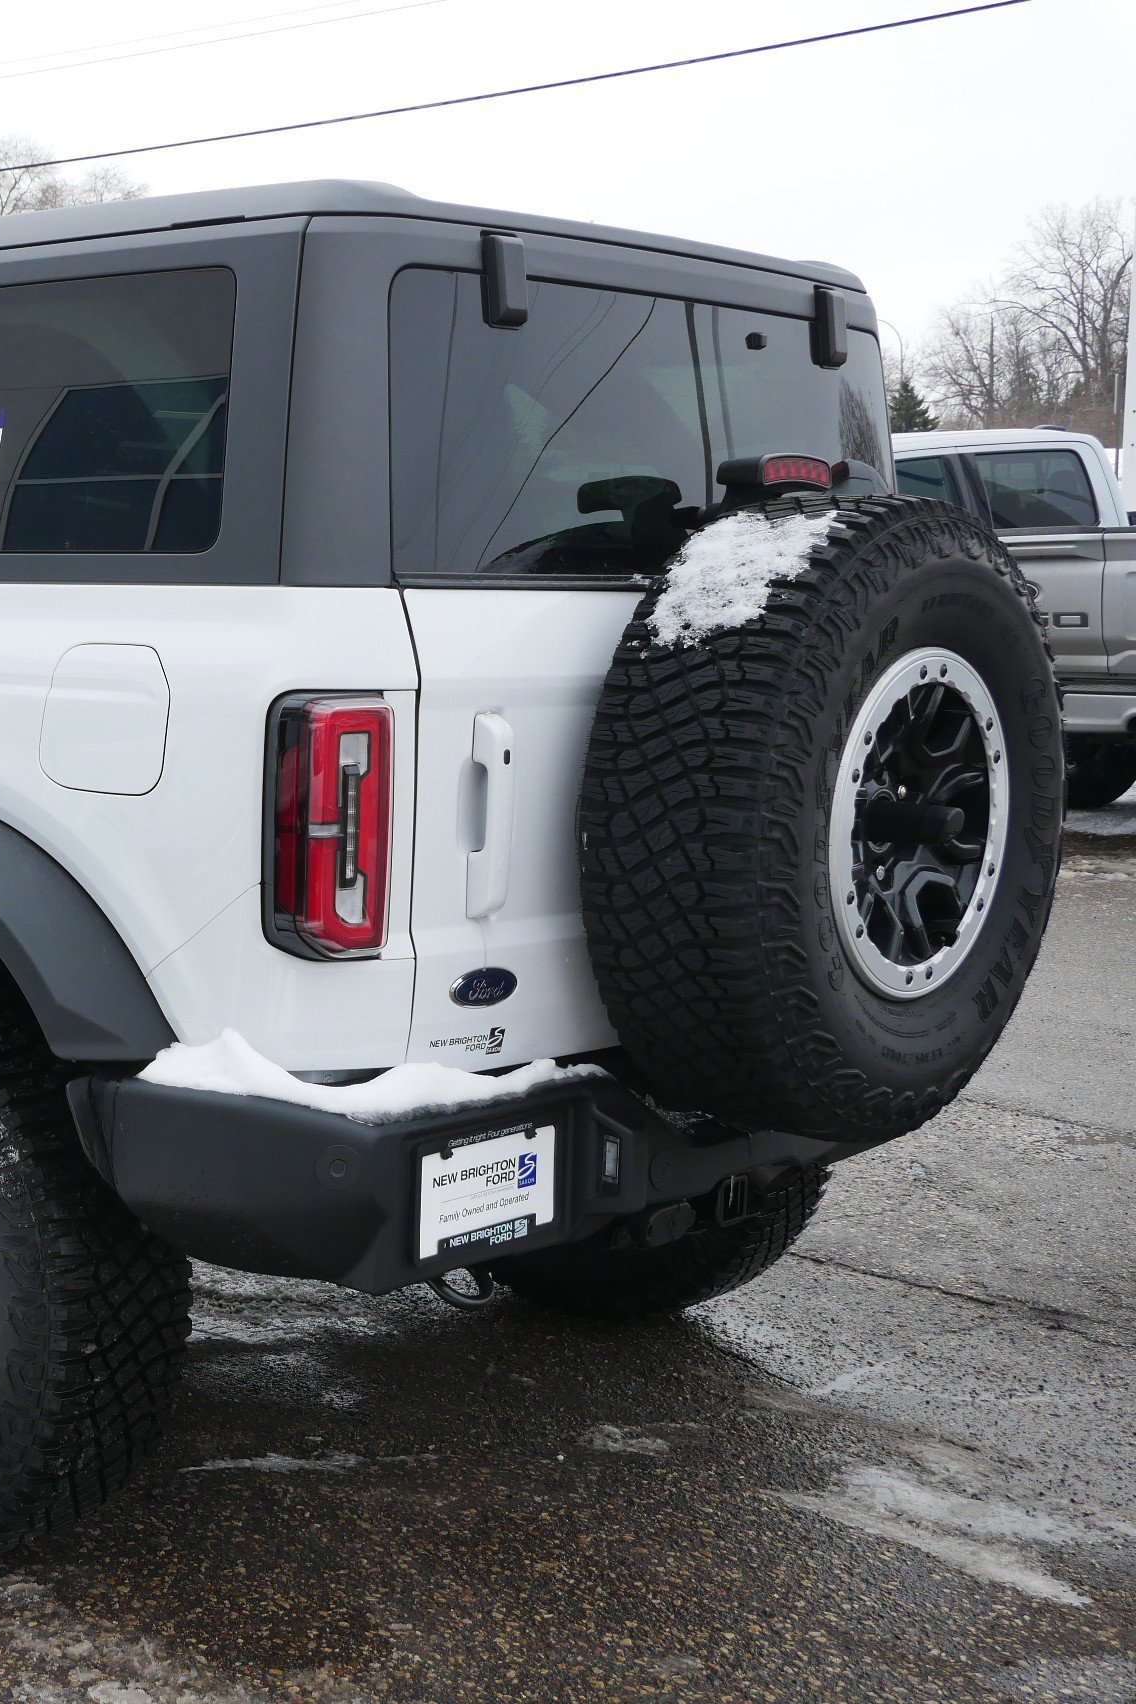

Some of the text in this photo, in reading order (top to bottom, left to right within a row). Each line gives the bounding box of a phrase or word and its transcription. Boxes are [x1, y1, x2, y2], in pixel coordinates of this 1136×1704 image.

[468, 979, 505, 1001] Ford
[429, 1034, 490, 1049] NEW BRIGHTON
[465, 1042, 487, 1052] FORD
[447, 1136, 469, 1147] Getting
[487, 1129, 500, 1139] Four
[432, 1157, 516, 1189] NEW BRIGHTON
[485, 1170, 516, 1188] FORD
[518, 1177, 535, 1186] SAXON
[439, 1212, 461, 1224] Family
[461, 1203, 485, 1218] Owned
[485, 1200, 499, 1211] and
[499, 1192, 530, 1208] Operated
[449, 1221, 513, 1248] NEW BRIGHTON
[489, 1231, 513, 1246] FORD
